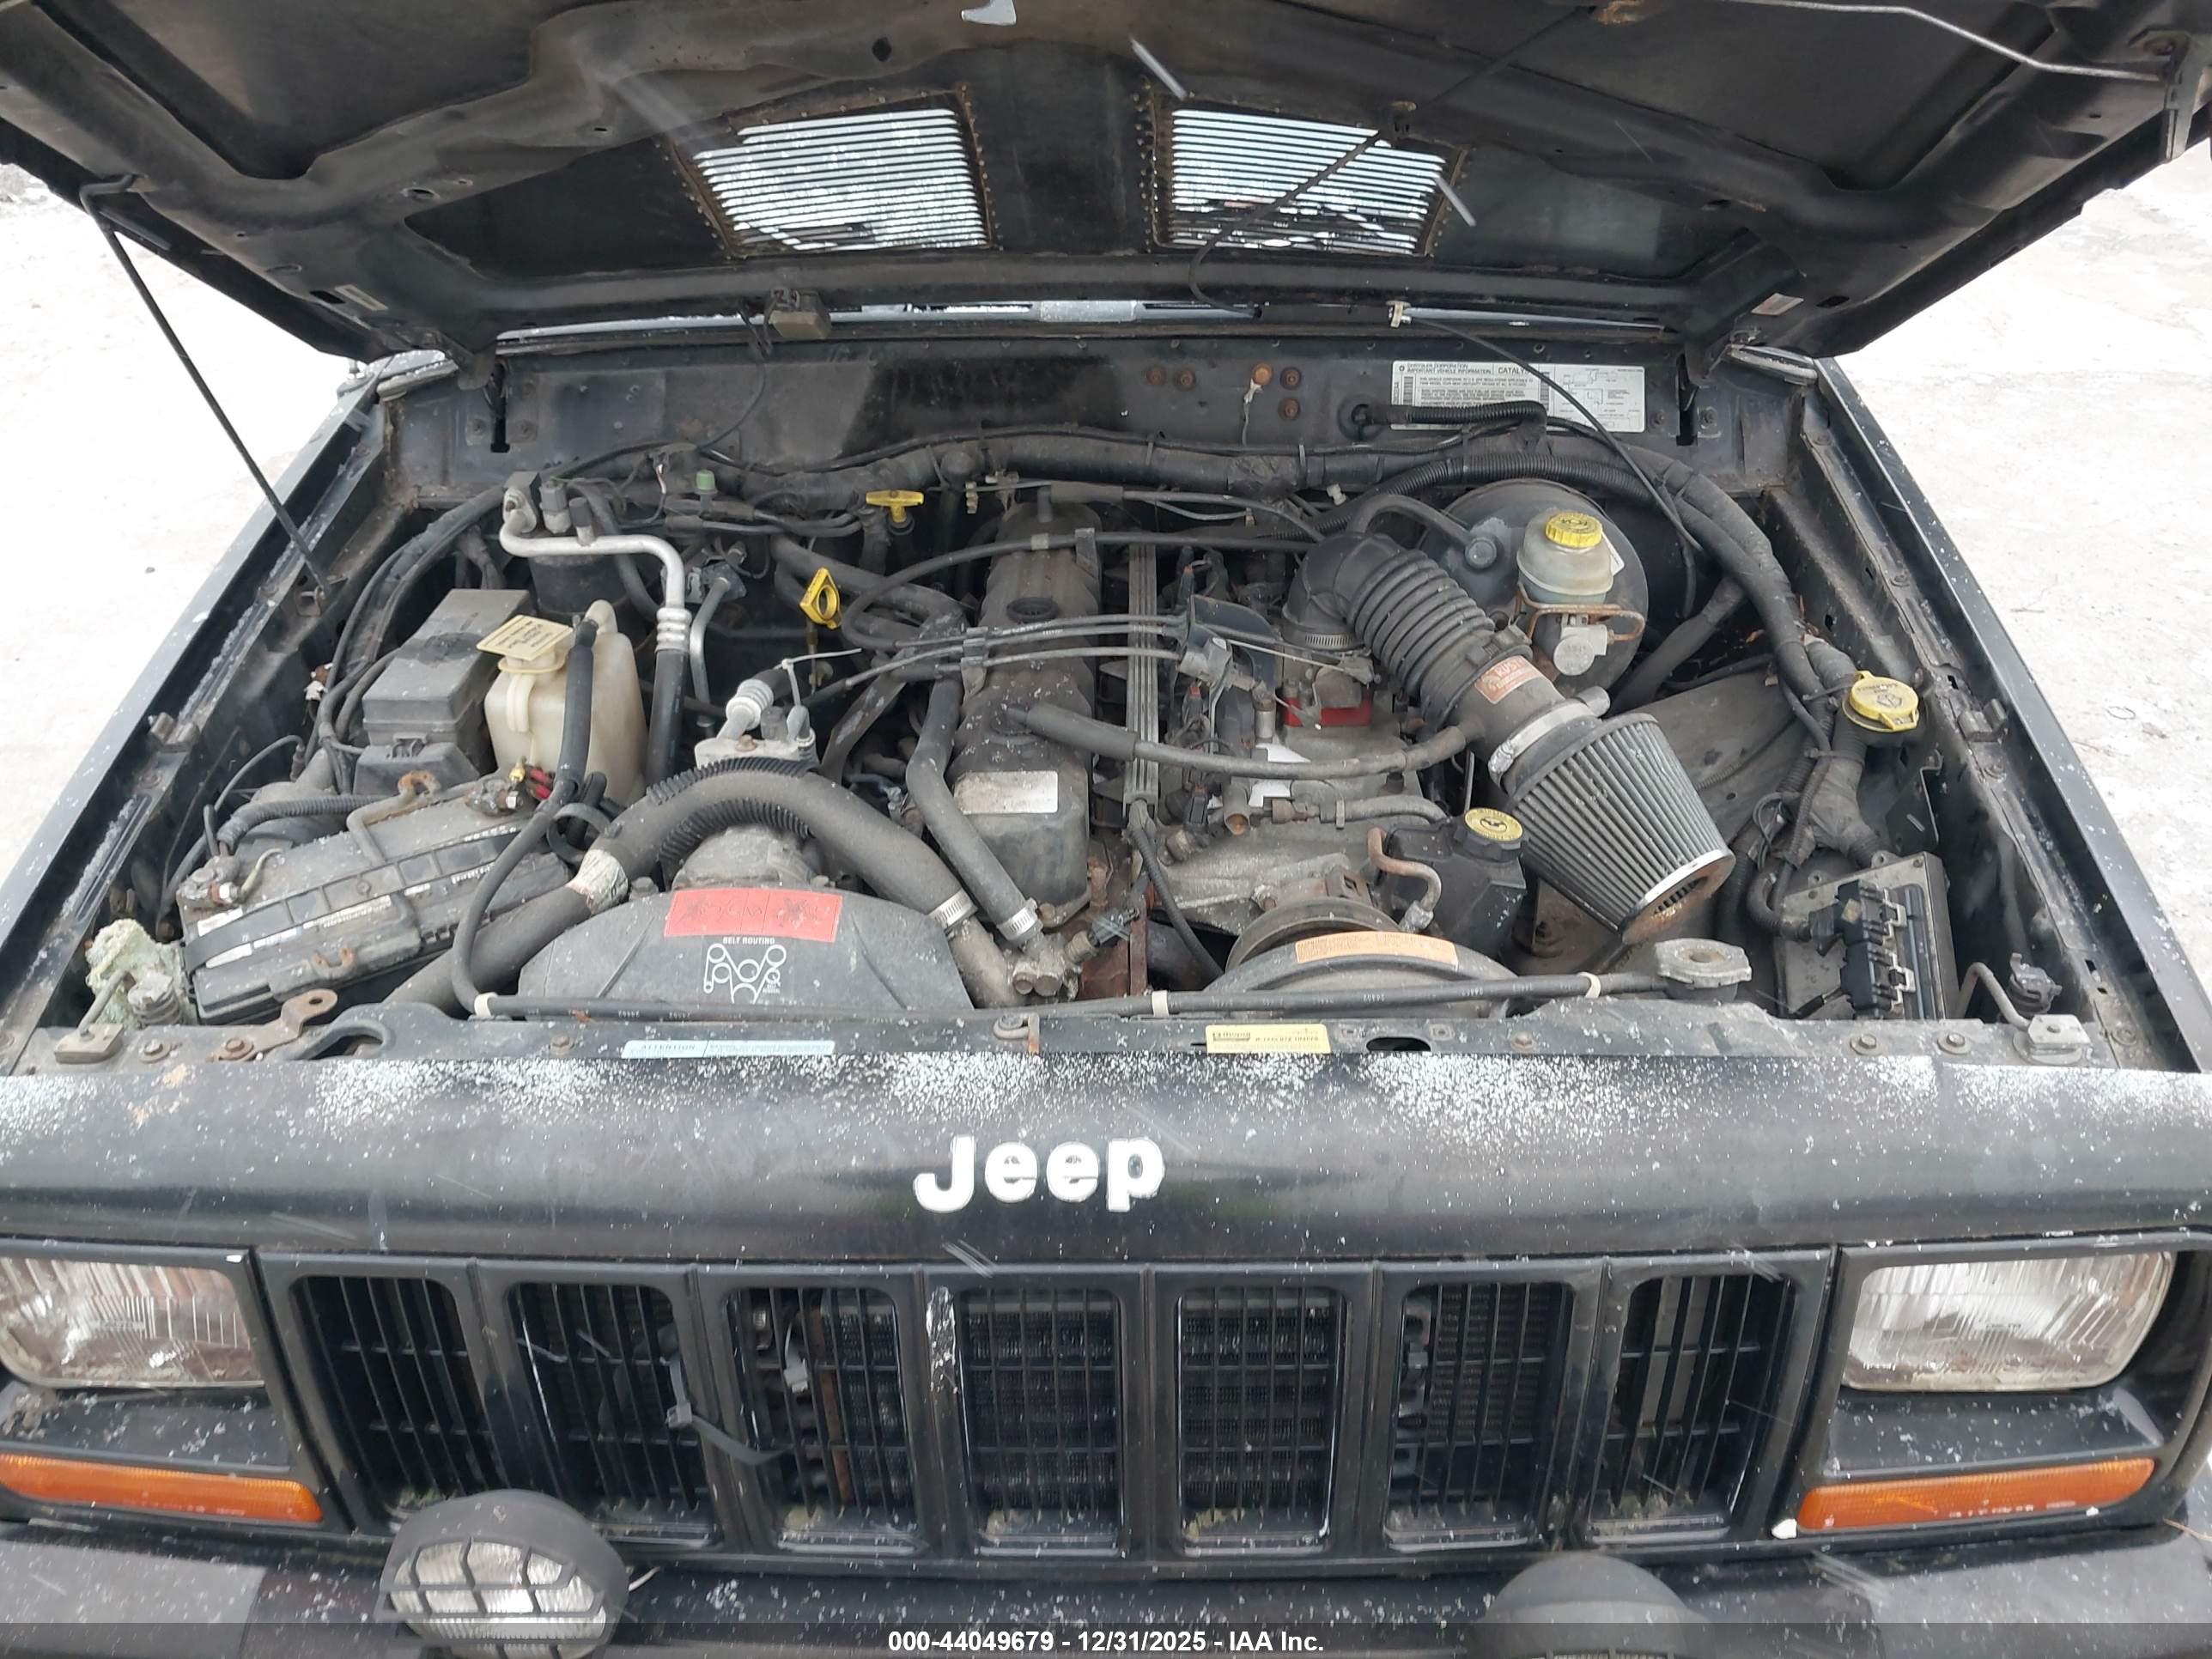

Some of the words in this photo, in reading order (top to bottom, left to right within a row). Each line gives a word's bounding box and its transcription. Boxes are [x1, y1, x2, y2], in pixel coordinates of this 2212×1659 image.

[723, 936, 742, 945] BELT
[742, 936, 775, 945] ROUTING
[913, 1134, 1165, 1212] Jeep
